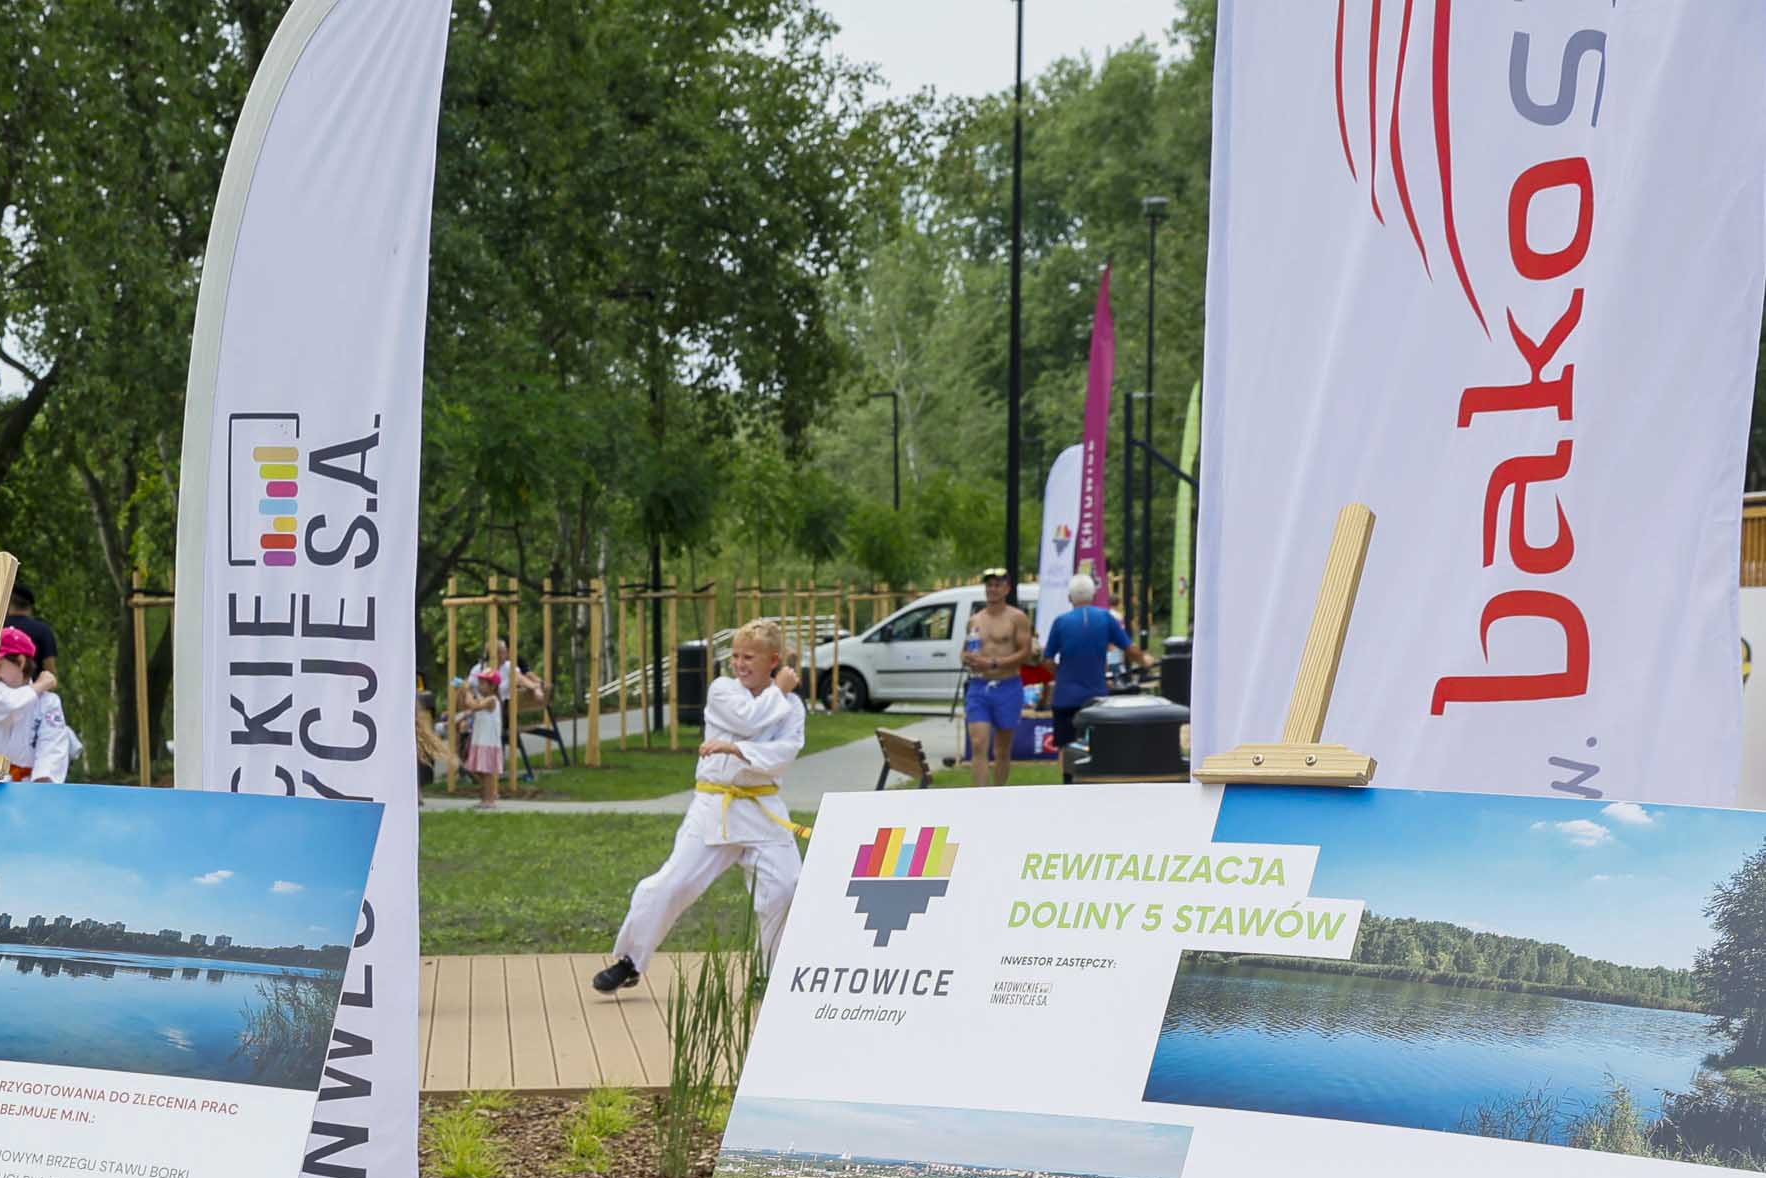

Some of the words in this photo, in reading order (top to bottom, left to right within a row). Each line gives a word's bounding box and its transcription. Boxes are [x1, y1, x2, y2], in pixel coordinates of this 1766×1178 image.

[304, 413, 381, 569] S.A.
[1020, 852, 1286, 886] REWITALIZACJA
[1008, 901, 1135, 930] DOLINY
[1141, 903, 1163, 931] 5
[1172, 902, 1347, 940] STAWÓW
[1000, 956, 1053, 967] INWESTOR
[1055, 957, 1117, 970] ZASTĘPCZY:
[790, 967, 954, 997] KATOWICE
[814, 1004, 837, 1023] dla
[840, 1006, 907, 1027] odmiany
[108, 1090, 130, 1103] DO
[132, 1092, 196, 1110] ZLECENIA
[200, 1099, 239, 1115] PRAC
[45, 1153, 97, 1171] BRZEGU
[98, 1160, 147, 1176] STAWU
